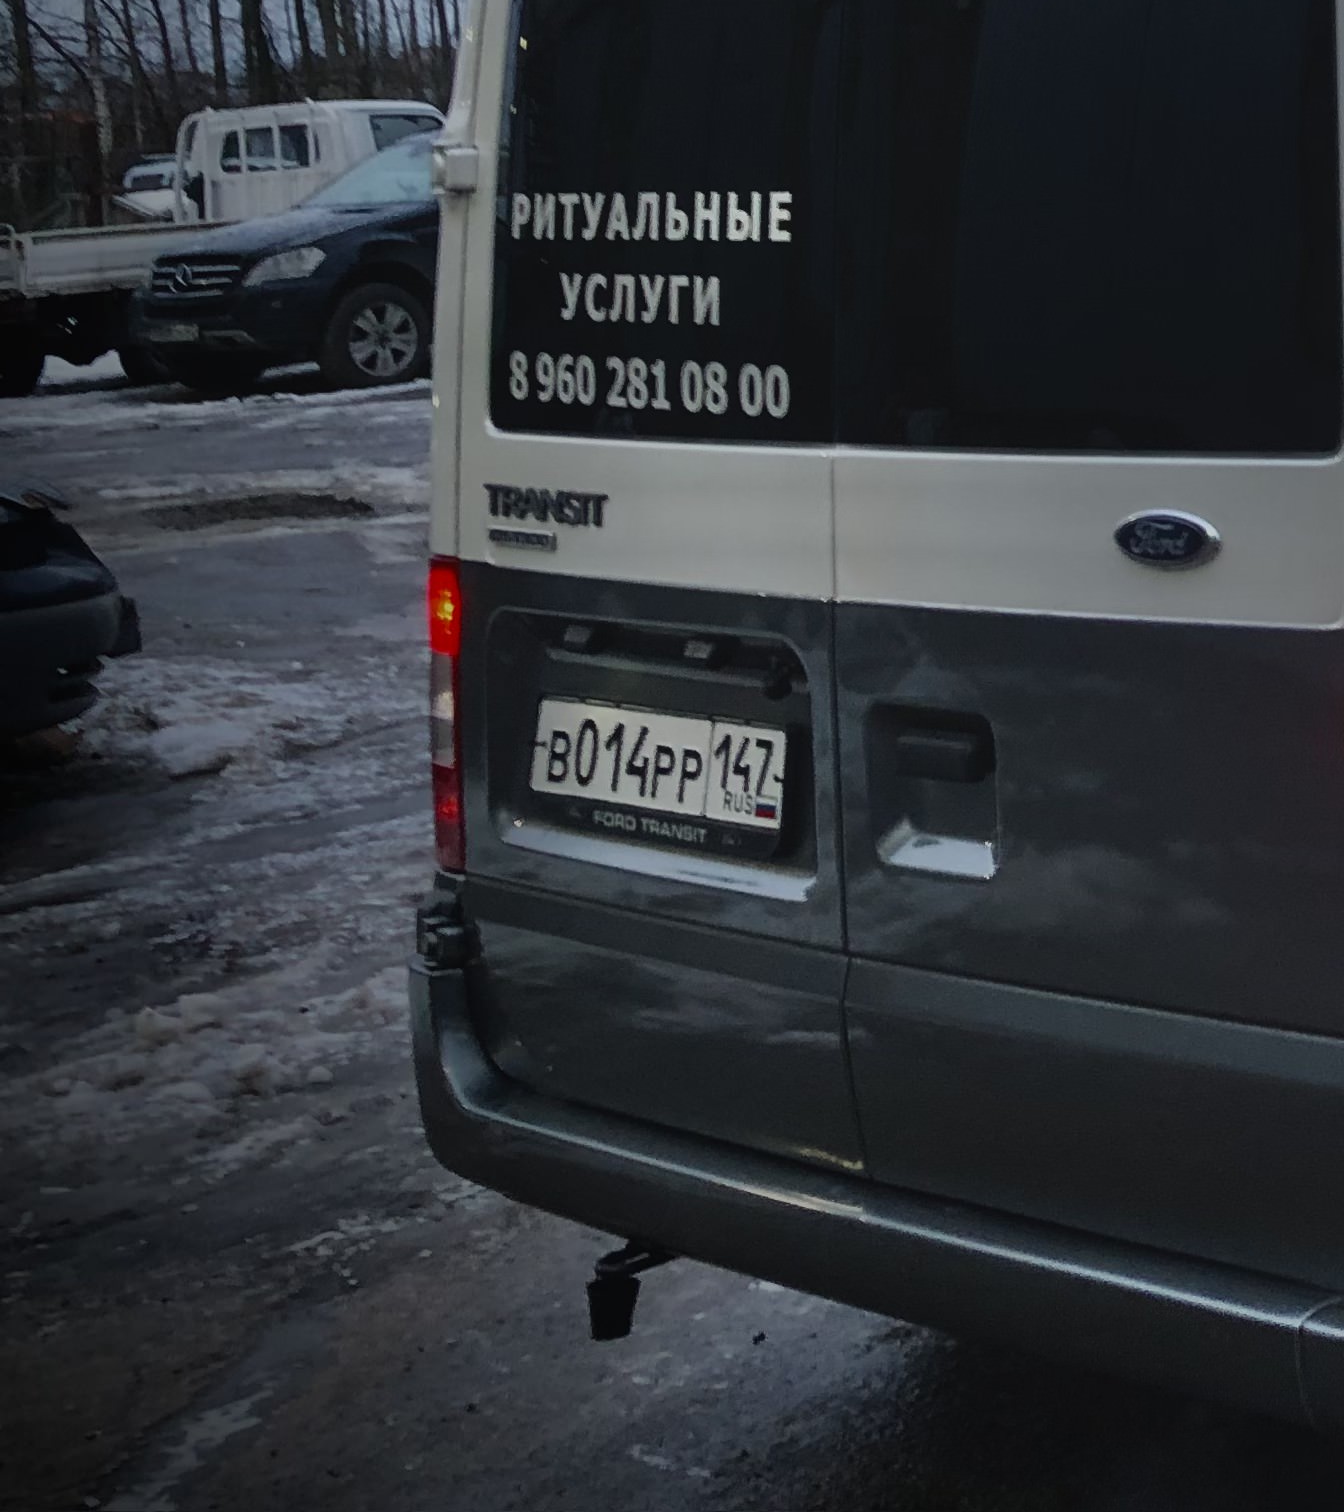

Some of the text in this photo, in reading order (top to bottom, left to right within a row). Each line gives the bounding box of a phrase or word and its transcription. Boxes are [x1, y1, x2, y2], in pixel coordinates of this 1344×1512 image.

[511, 191, 792, 242] РИТУАЛЬНЫЕ
[559, 272, 721, 326] УСЛУГИ
[509, 350, 790, 419] 8 960 281 08 00
[483, 483, 609, 528] TRANSIT
[714, 734, 774, 794] 147
[593, 809, 637, 833] FORD
[640, 817, 708, 845] TRANSIT
[722, 790, 755, 816] RUS
